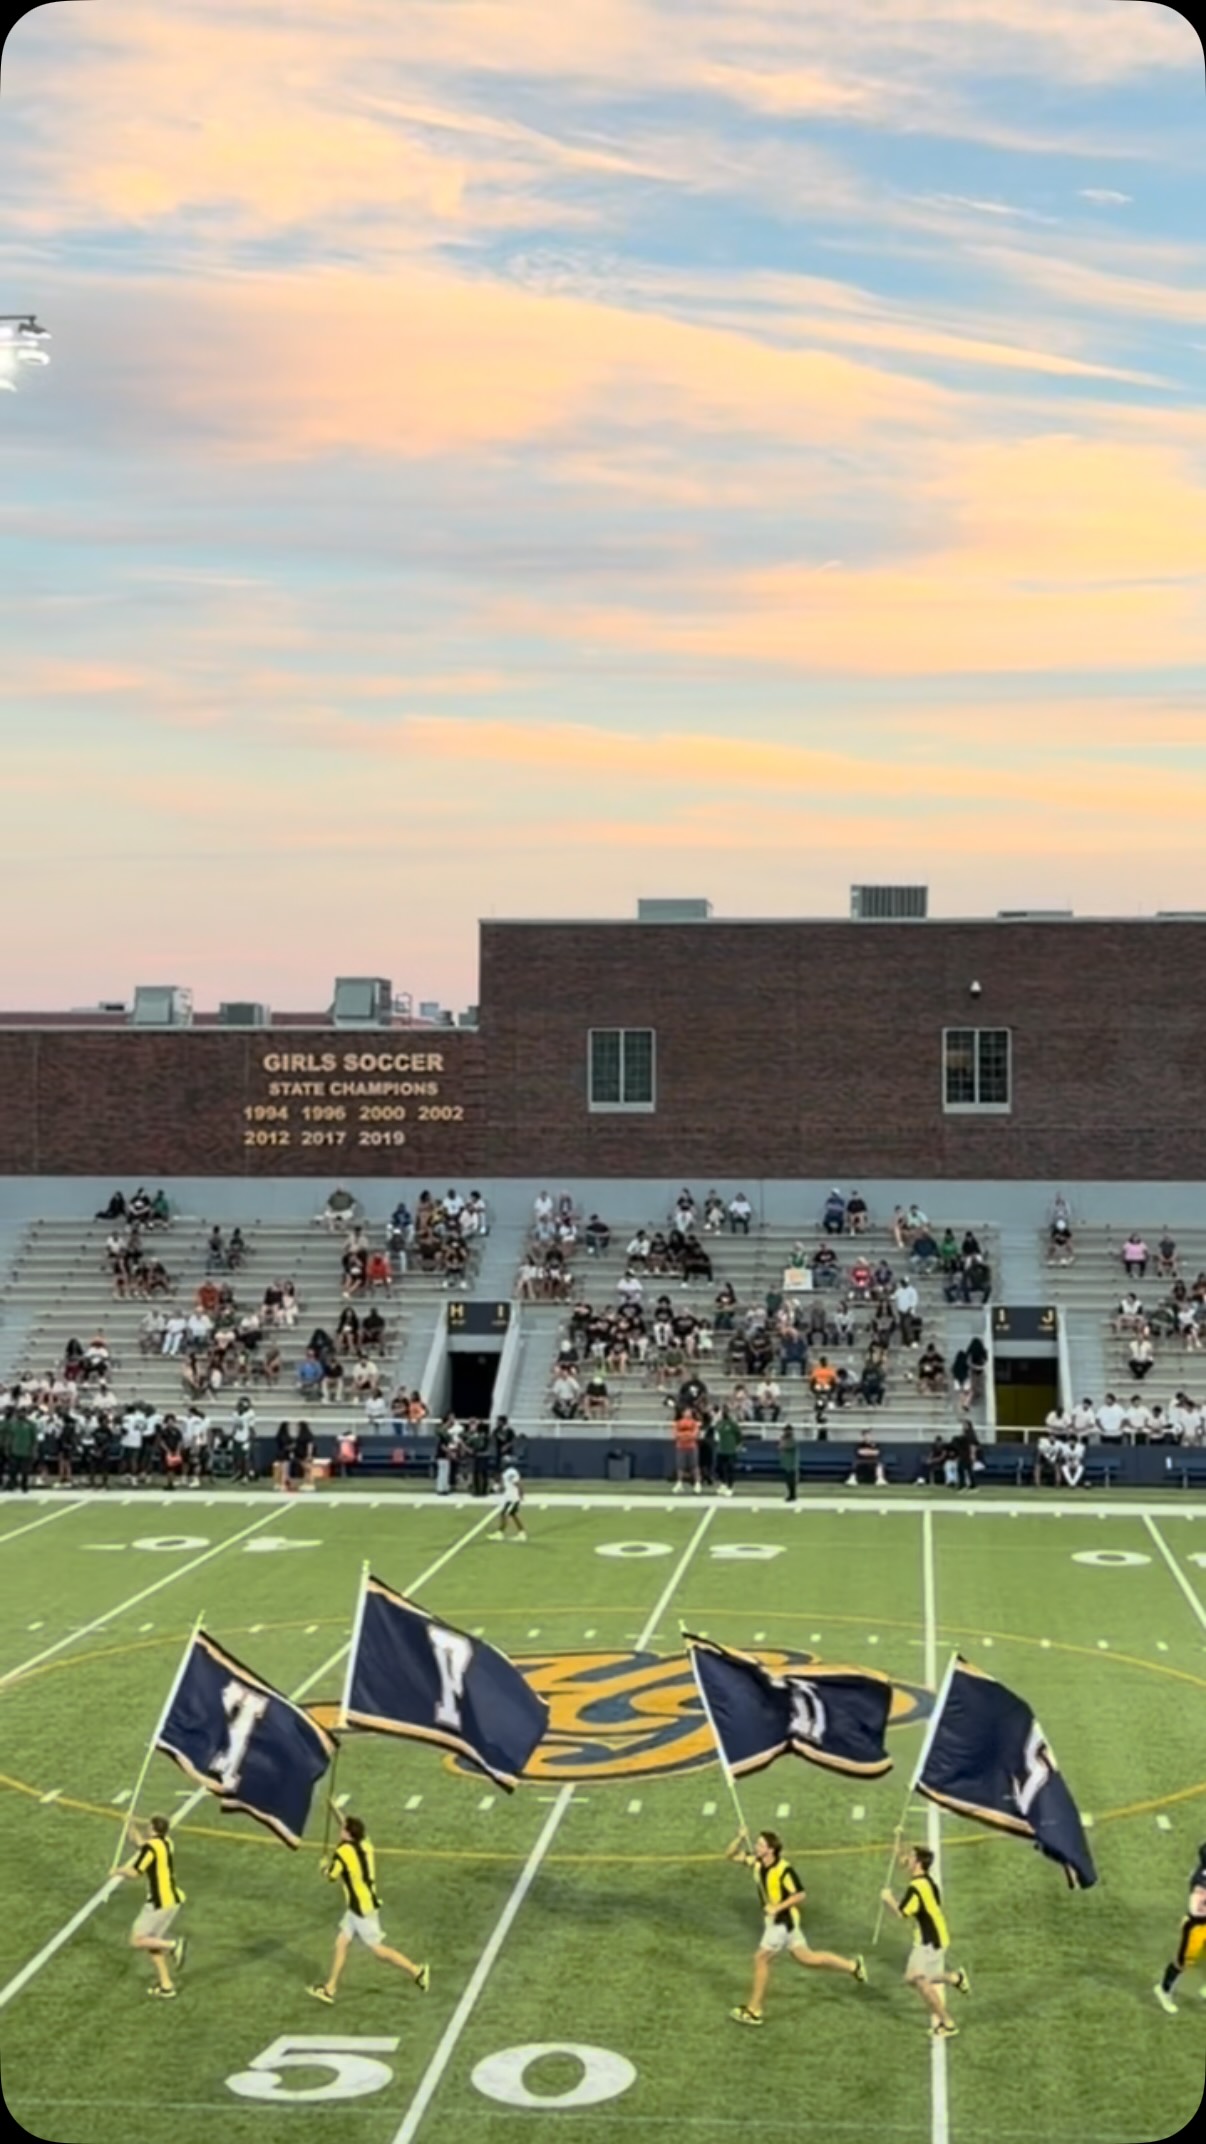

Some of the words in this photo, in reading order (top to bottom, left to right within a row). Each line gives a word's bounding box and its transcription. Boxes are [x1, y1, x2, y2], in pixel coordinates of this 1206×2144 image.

[263, 1053, 337, 1072] GIRLS
[343, 1053, 444, 1072] SOCCER
[269, 1081, 325, 1096] STATE
[330, 1081, 439, 1096] CHAMPIONS
[244, 1105, 289, 1121] 1994
[302, 1105, 347, 1121] 1996
[358, 1105, 405, 1121] 2000
[417, 1105, 464, 1121] 2002
[244, 1130, 290, 1146] 2012
[301, 1130, 347, 1146] 2017
[358, 1130, 405, 1146] 2019
[450, 1304, 464, 1318] H
[1042, 1309, 1054, 1325] J
[225, 2035, 637, 2107] 50
